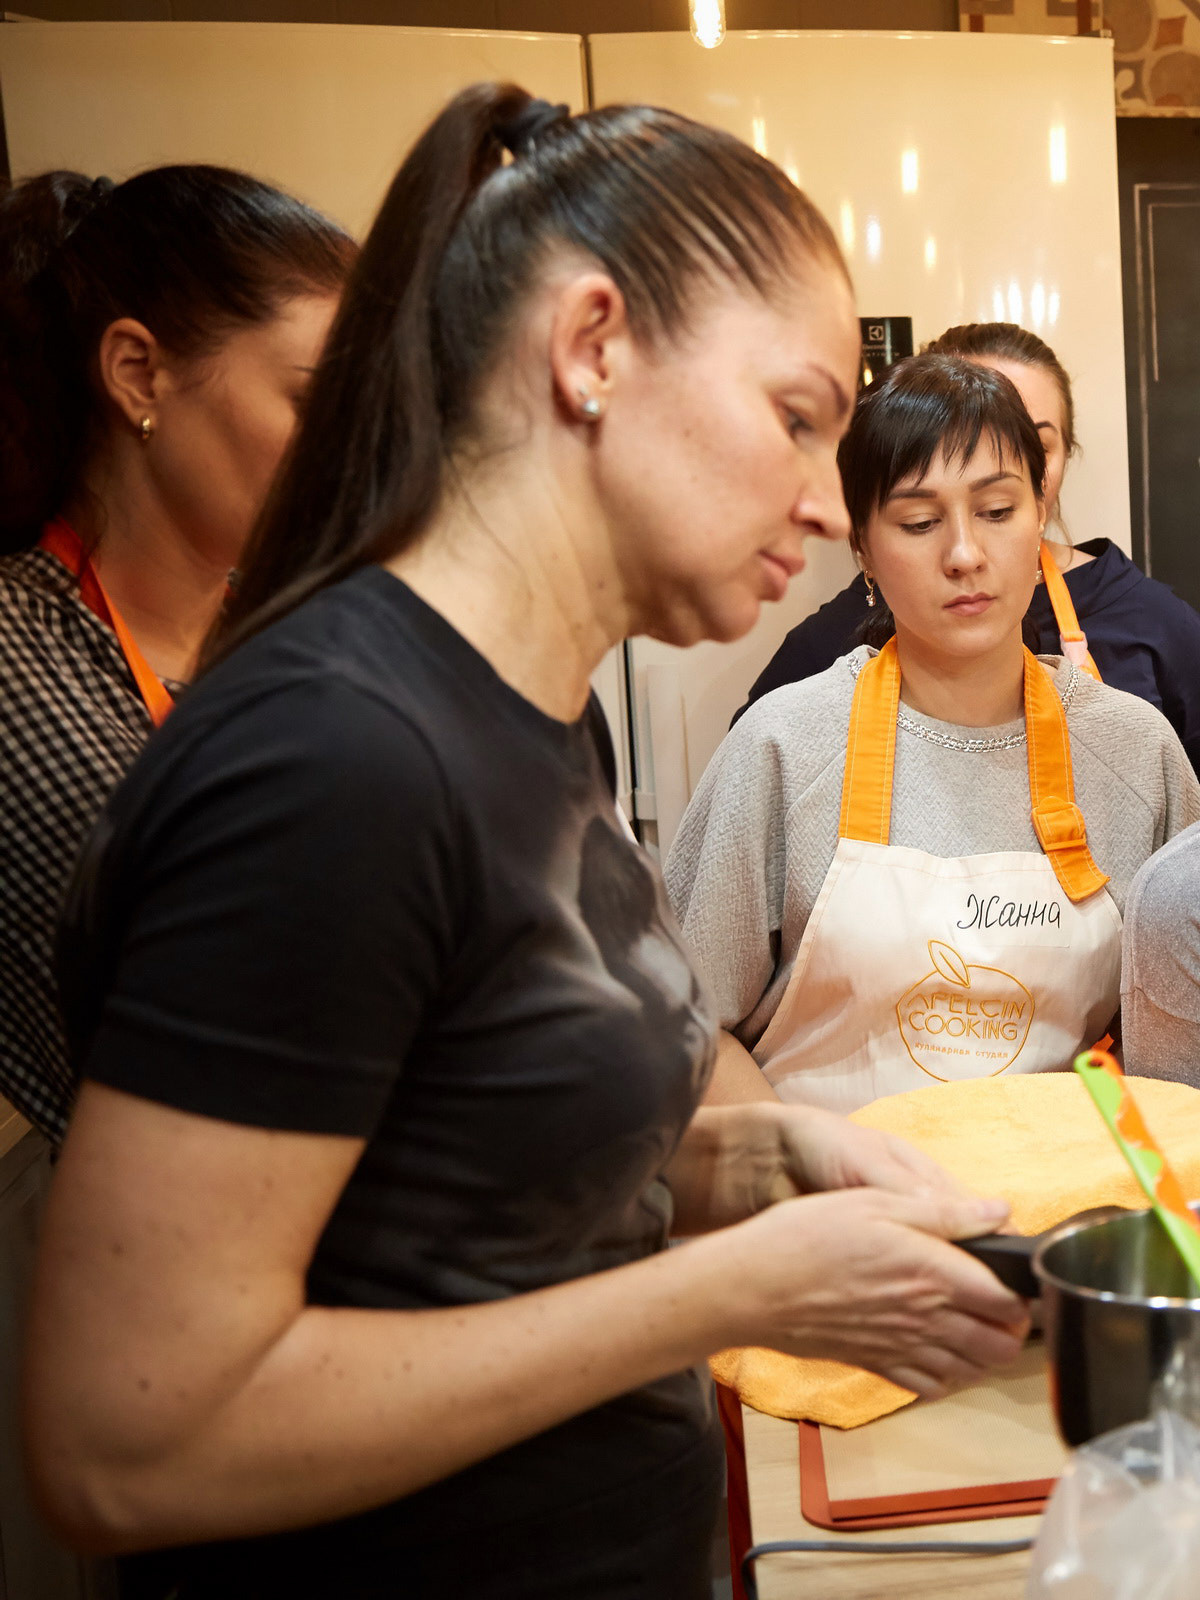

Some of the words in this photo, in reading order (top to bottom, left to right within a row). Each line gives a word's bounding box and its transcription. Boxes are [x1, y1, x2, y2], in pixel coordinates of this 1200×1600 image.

[956, 893, 1061, 930] Жанна
[906, 992, 1026, 1019] APELCIN
[908, 1010, 1018, 1041] COOKING
[914, 1041, 971, 1056] кулинарная
[975, 1049, 1009, 1060] студия
